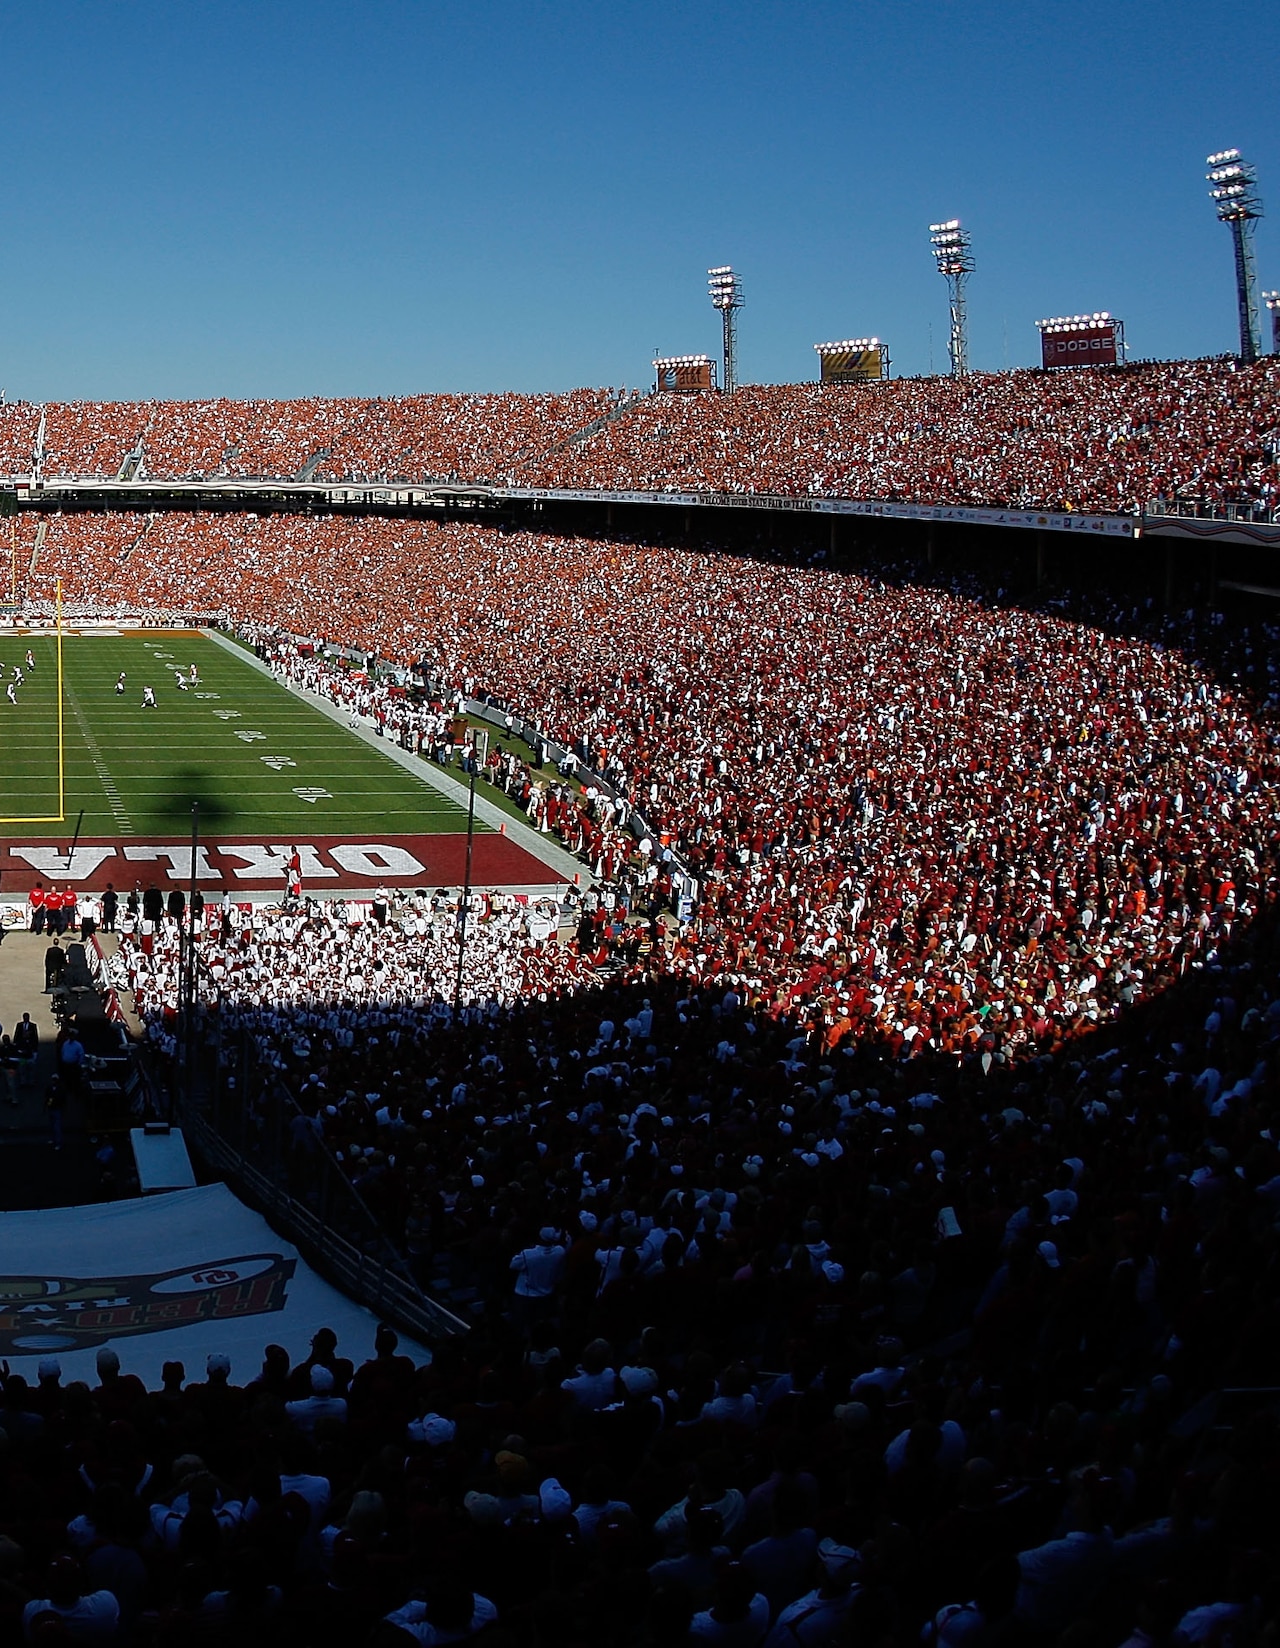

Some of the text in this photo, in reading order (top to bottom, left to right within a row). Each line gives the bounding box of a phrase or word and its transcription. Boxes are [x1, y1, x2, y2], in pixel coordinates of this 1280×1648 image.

[1056, 337, 1113, 353] DODGE
[679, 370, 702, 385] at&t
[699, 495, 730, 506] WELCOME
[748, 496, 767, 508] STATE
[768, 498, 783, 509] FAIR
[791, 499, 813, 510] TEXAS
[75, 1273, 282, 1328] RED
